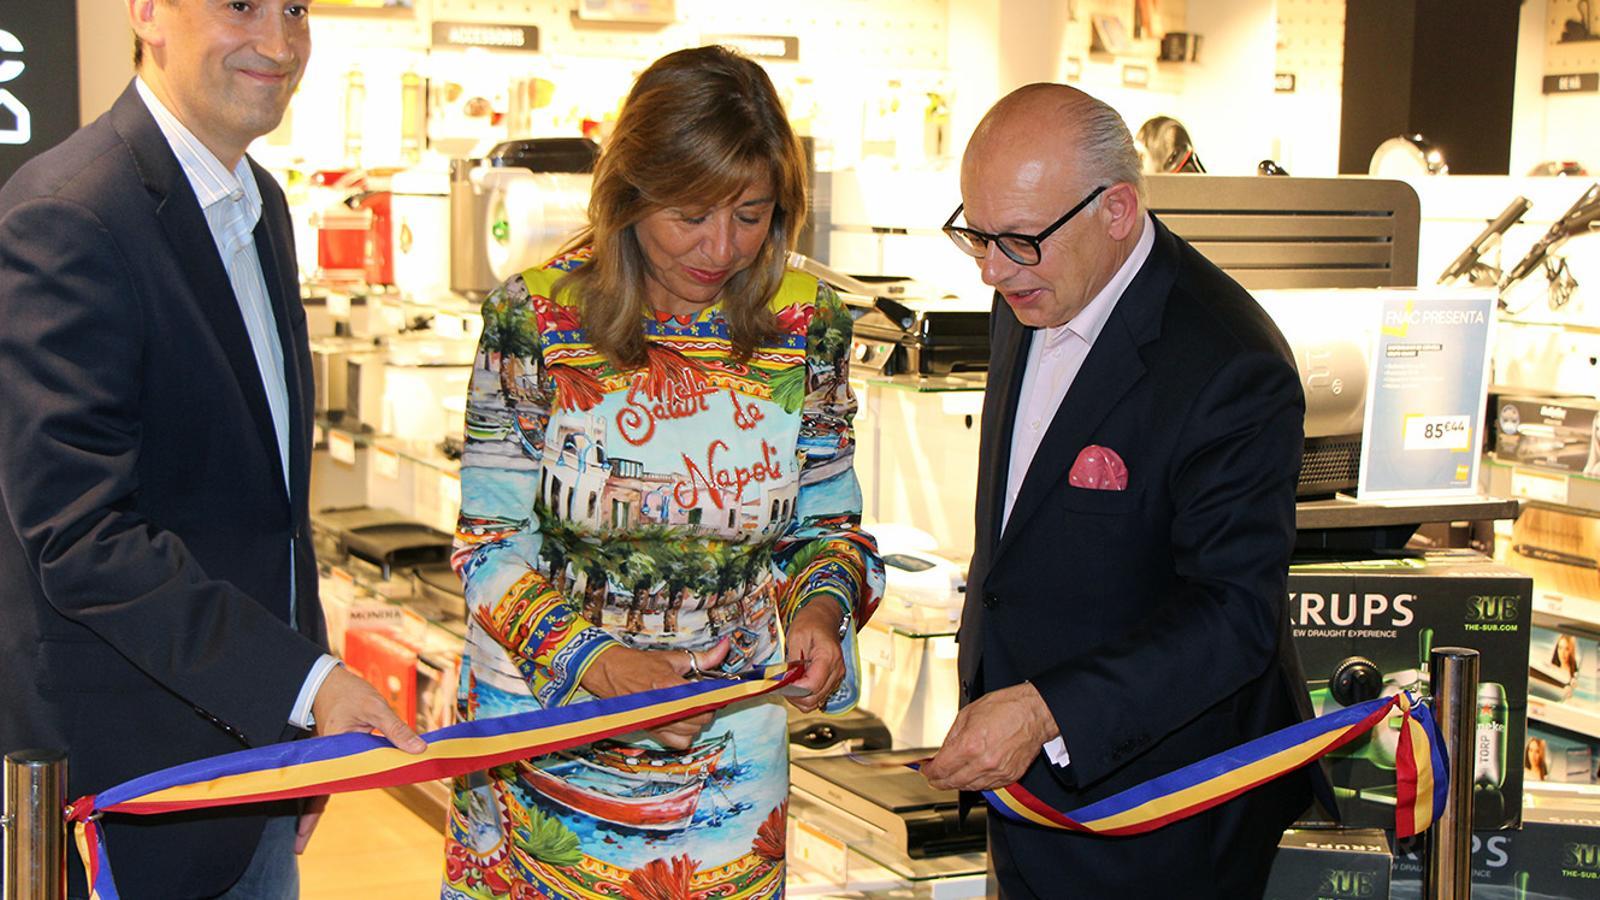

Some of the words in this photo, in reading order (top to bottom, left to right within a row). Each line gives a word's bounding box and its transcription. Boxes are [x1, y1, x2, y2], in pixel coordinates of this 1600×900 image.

[1386, 310, 1420, 325] FNAC
[1422, 310, 1484, 325] PRESENTA
[673, 438, 782, 510] Napoli
[1465, 596, 1520, 621] SUB
[1292, 629, 1306, 637] EW
[1307, 629, 1346, 637] DRAUGHT
[1464, 624, 1518, 632] THE-SUB.COM
